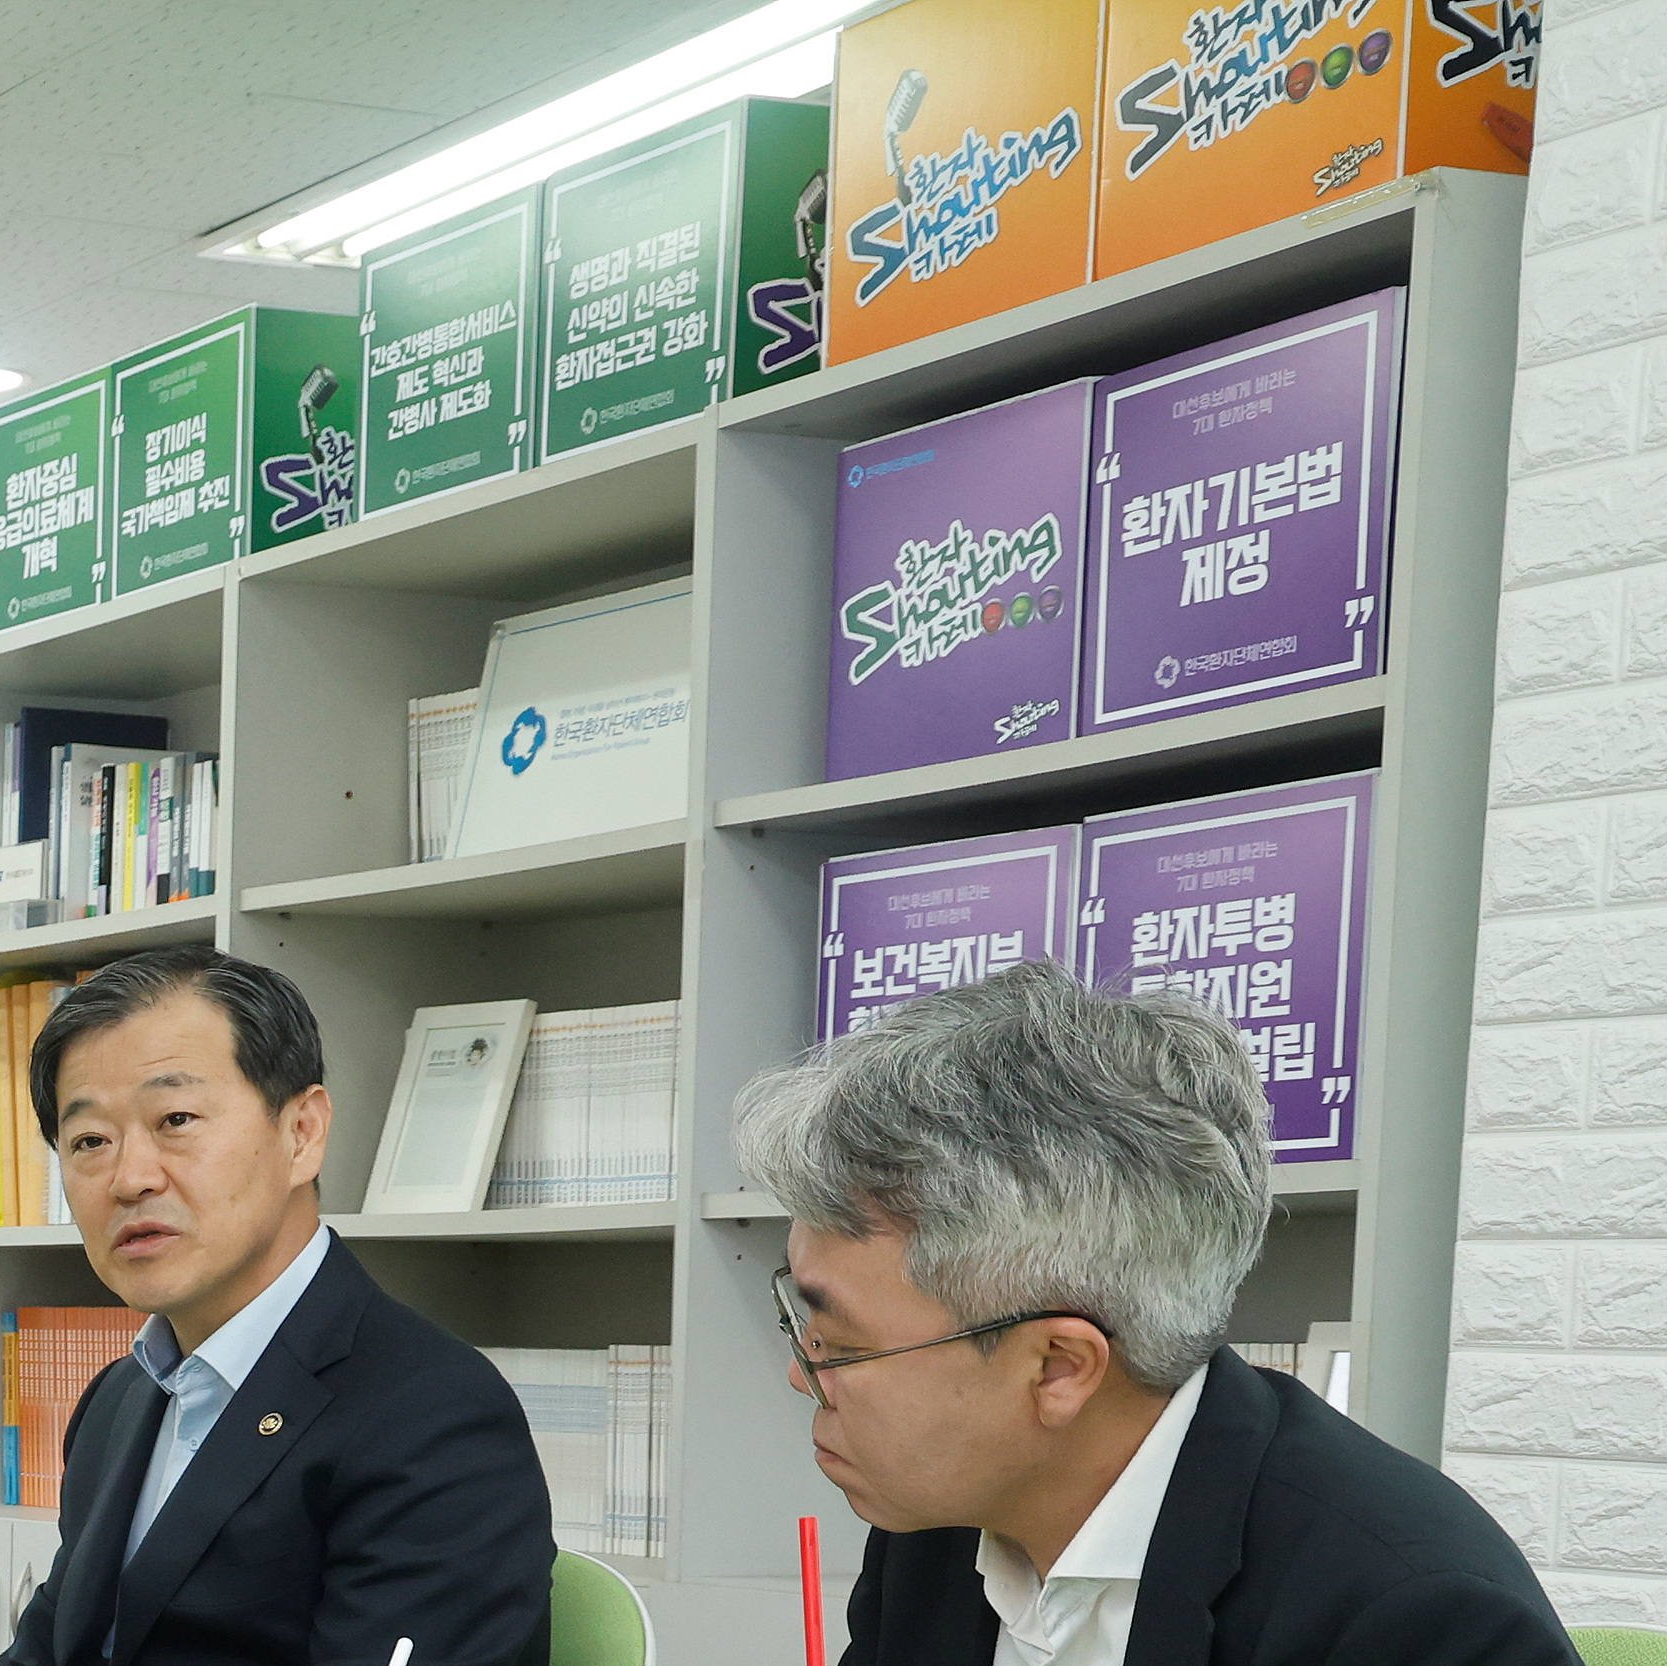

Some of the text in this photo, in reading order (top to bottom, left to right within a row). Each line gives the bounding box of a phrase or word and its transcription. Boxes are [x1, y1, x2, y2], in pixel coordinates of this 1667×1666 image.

[905, 126, 987, 206] 환자
[846, 107, 1083, 307] Shouting
[569, 220, 701, 300] 생명과 직결된
[370, 299, 517, 378] 간호간병통합서비스
[567, 267, 699, 344] 신약의 신속한
[395, 345, 485, 403] 제도 혁신과
[554, 325, 657, 391] 환자접근권
[662, 309, 709, 357] 강화
[145, 412, 208, 464] 장기이식
[387, 379, 492, 442] 간병사 제도화
[6, 453, 78, 511] 환자중심
[121, 487, 196, 538] 국가책임제
[197, 474, 230, 514] 추진
[145, 448, 206, 499] 필수비용
[1120, 441, 1343, 558] 환자기본법
[21, 535, 58, 579] 개혁
[1179, 529, 1271, 608] 제정
[841, 513, 1063, 685] Shouting
[1184, 634, 1298, 677] 한국환자단체연합회
[553, 699, 689, 748] 한국환자단체연합회
[1131, 892, 1296, 968] 환자투병
